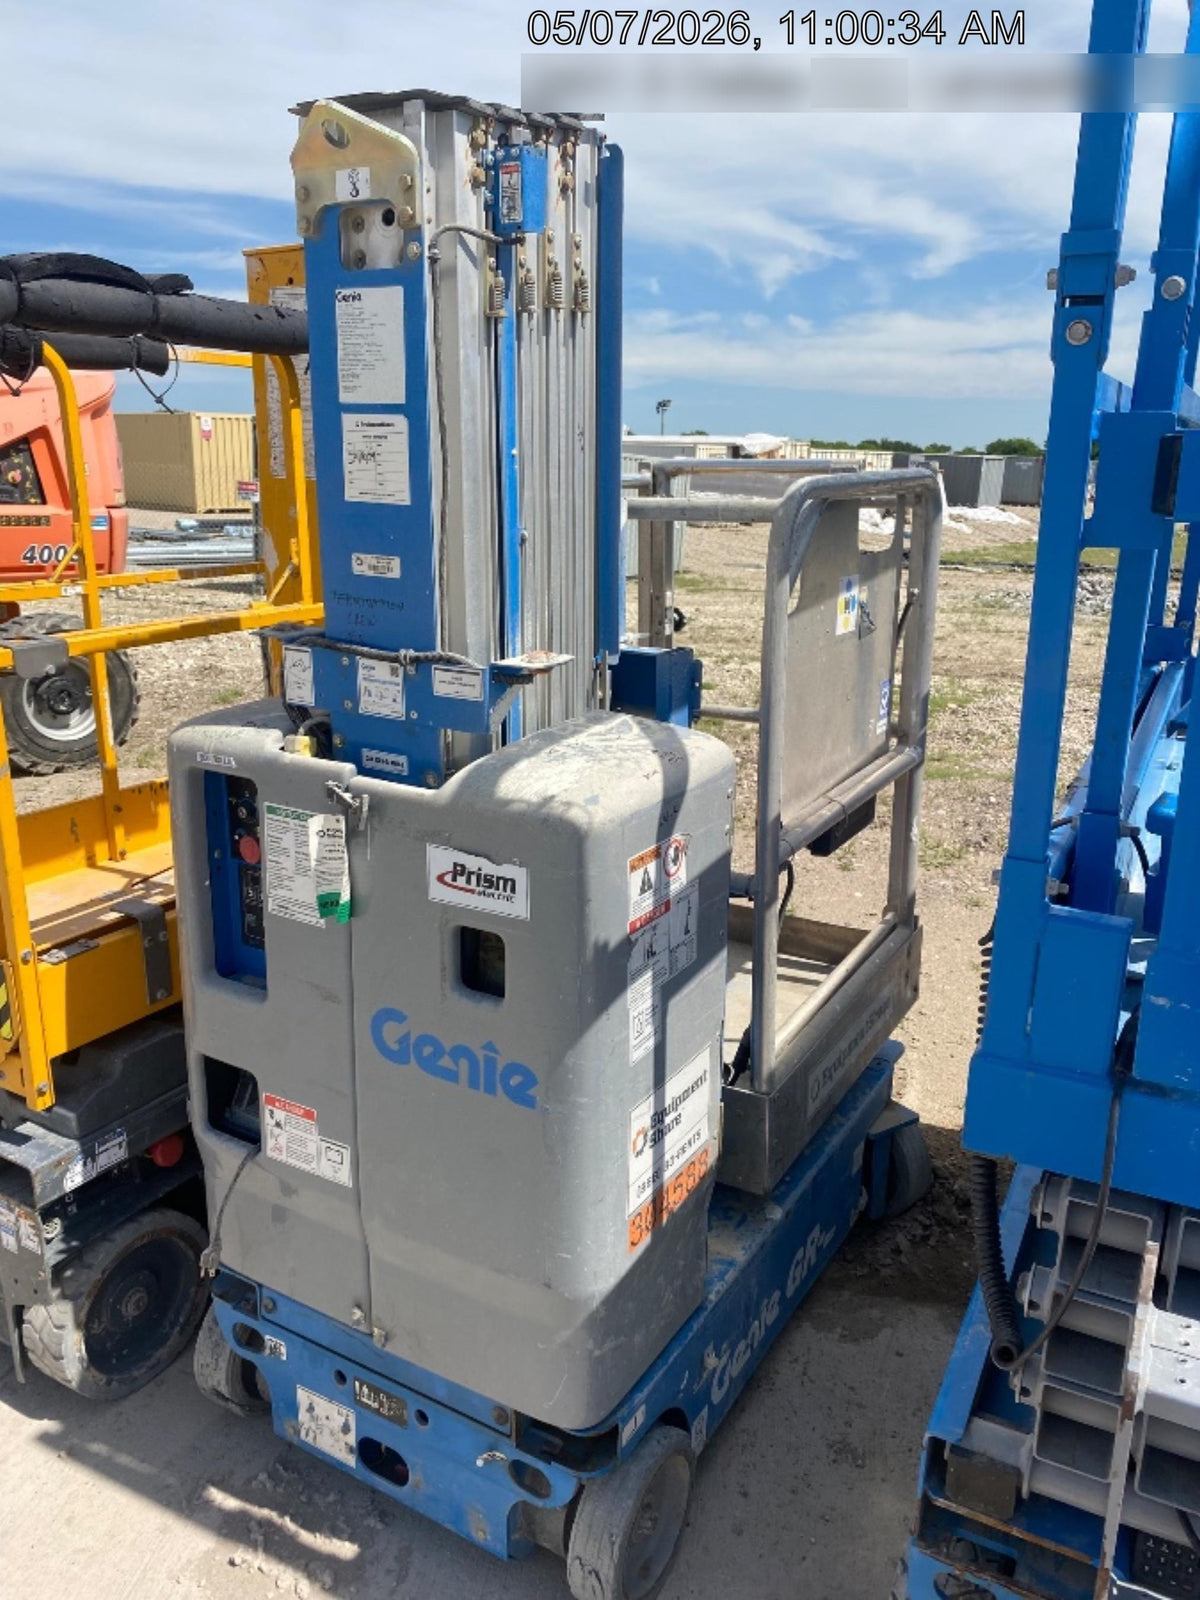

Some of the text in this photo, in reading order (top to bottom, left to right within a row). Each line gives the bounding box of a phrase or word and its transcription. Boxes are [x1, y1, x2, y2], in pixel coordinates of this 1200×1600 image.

[451, 861, 517, 895] Prism
[370, 1006, 539, 1110] Genie
[650, 1069, 708, 1128] Equipment
[649, 1111, 682, 1149] Share
[710, 1289, 782, 1405] Genie
